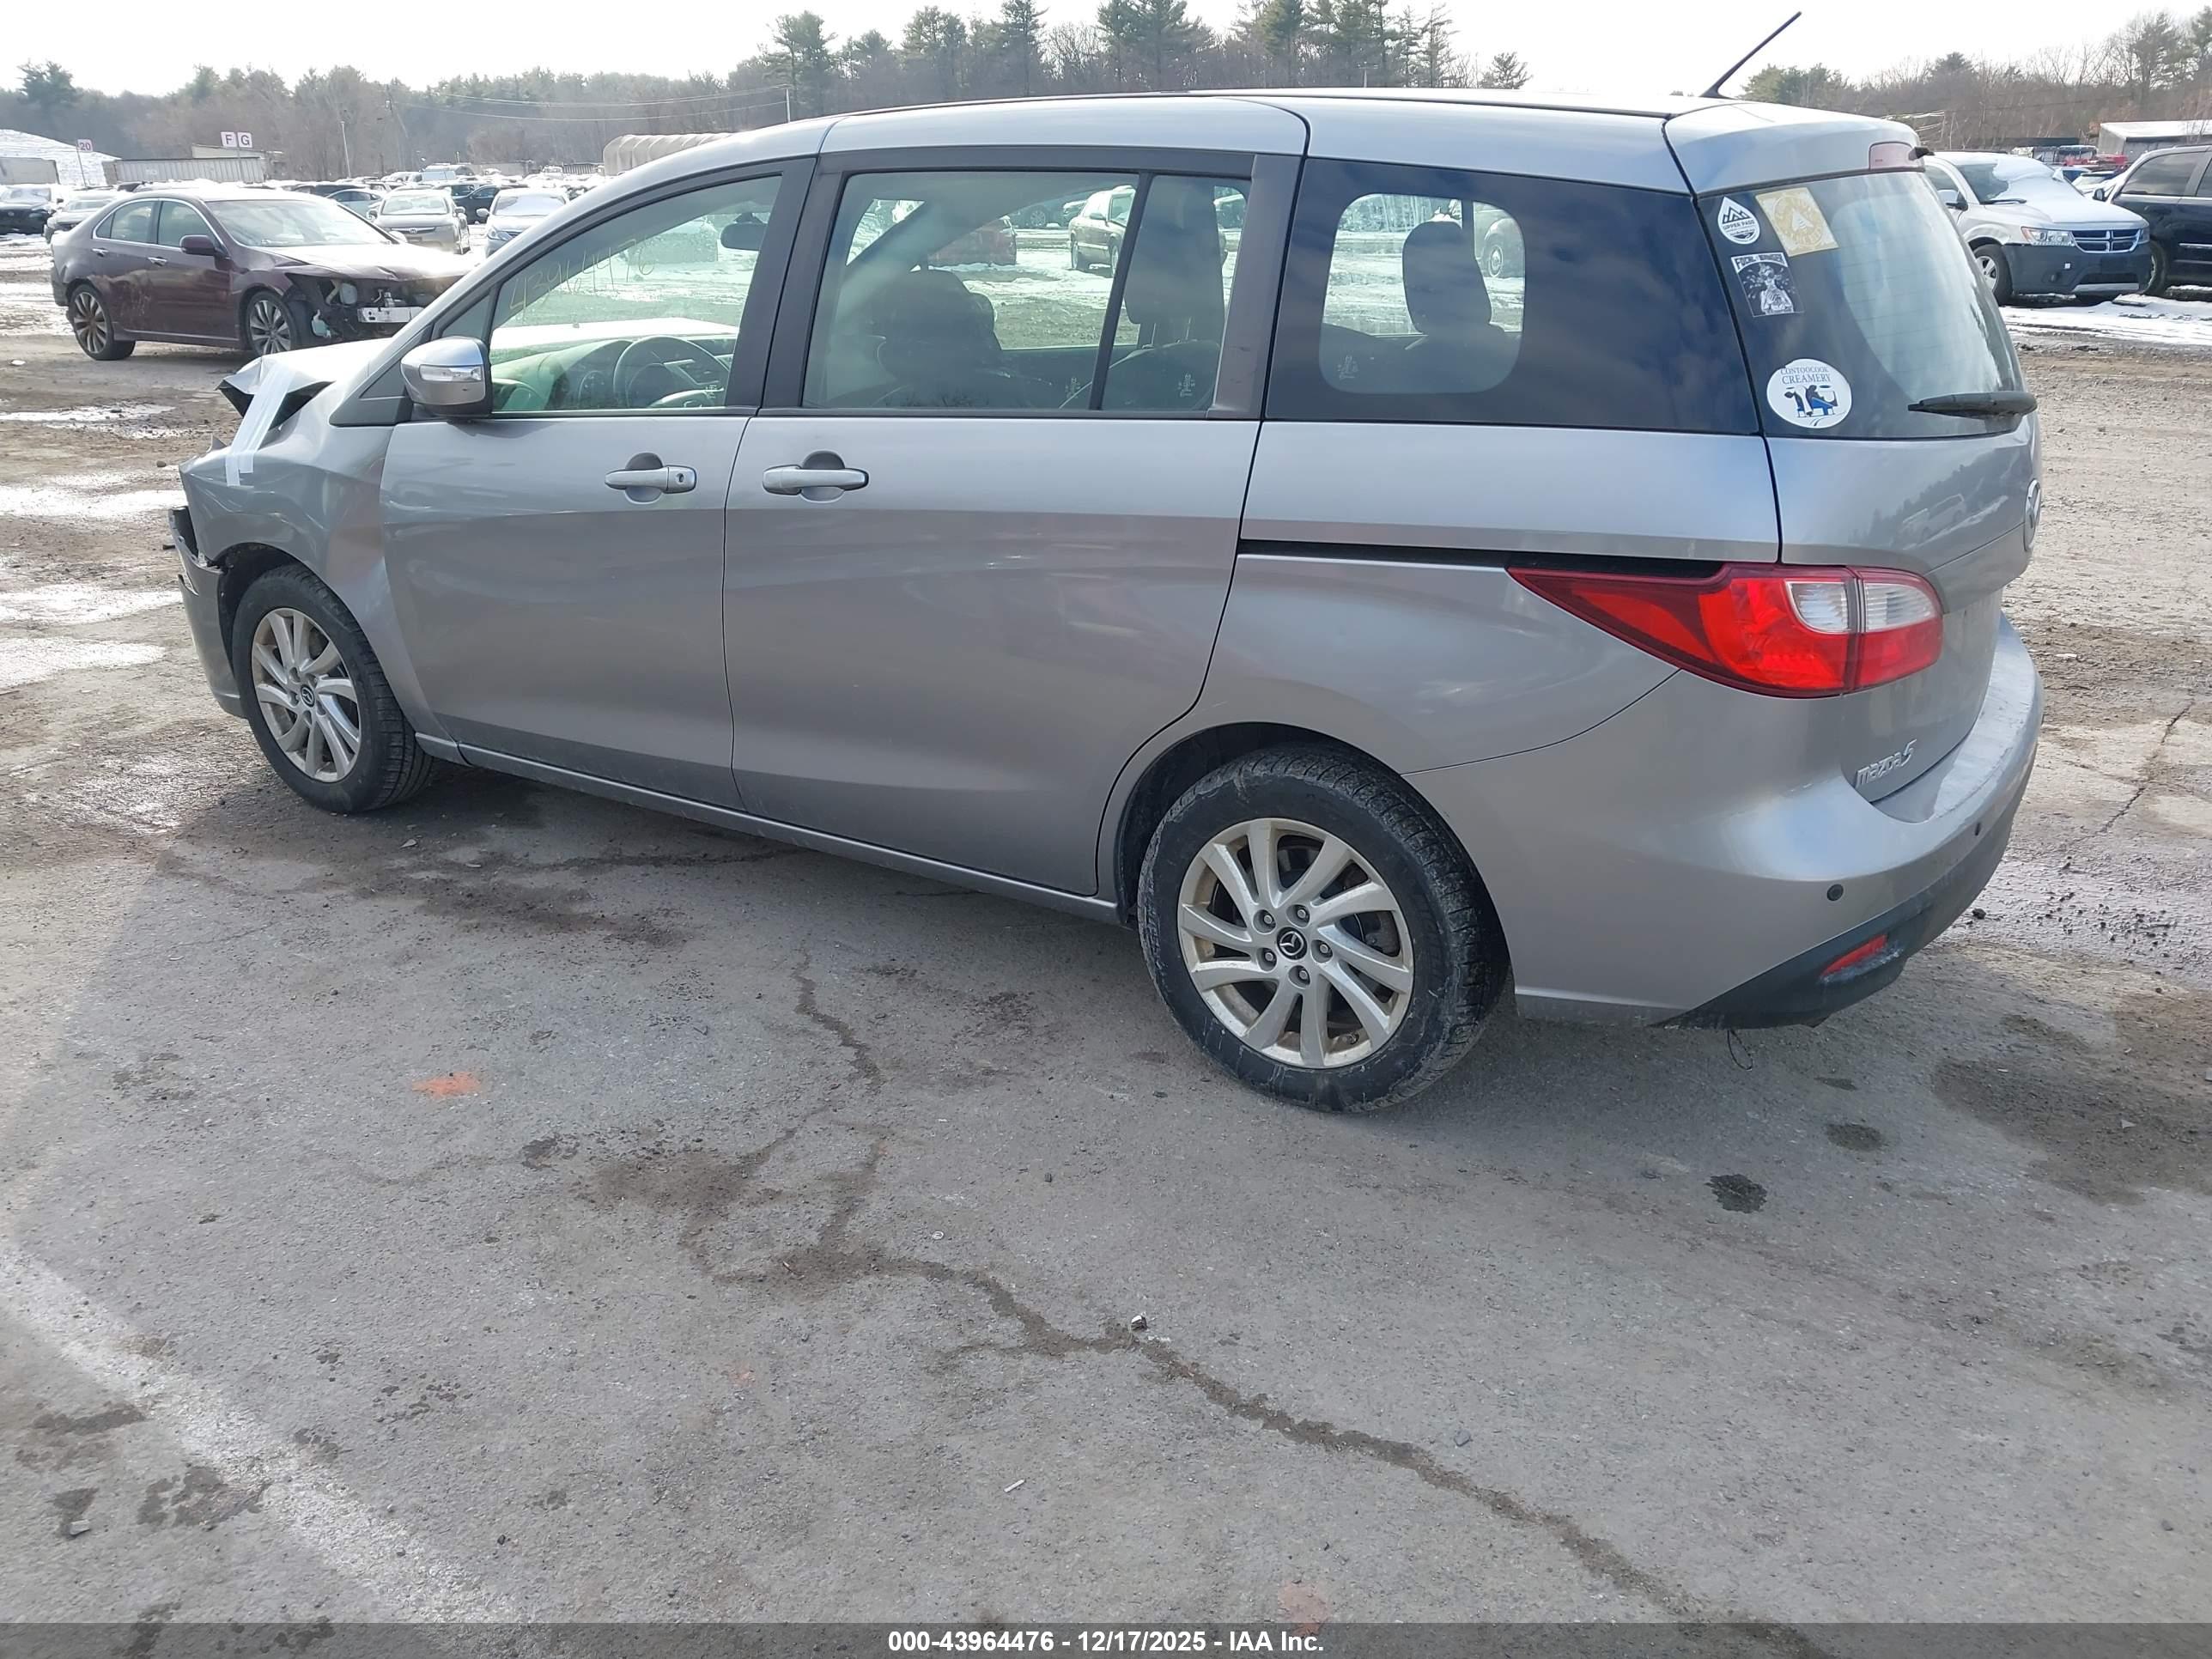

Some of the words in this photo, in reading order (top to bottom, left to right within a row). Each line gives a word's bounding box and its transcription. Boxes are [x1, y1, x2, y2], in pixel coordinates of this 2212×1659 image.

[225, 135, 233, 144] F
[241, 135, 250, 145] G
[79, 142, 91, 151] 20
[1782, 374, 1831, 385] CREAMERY
